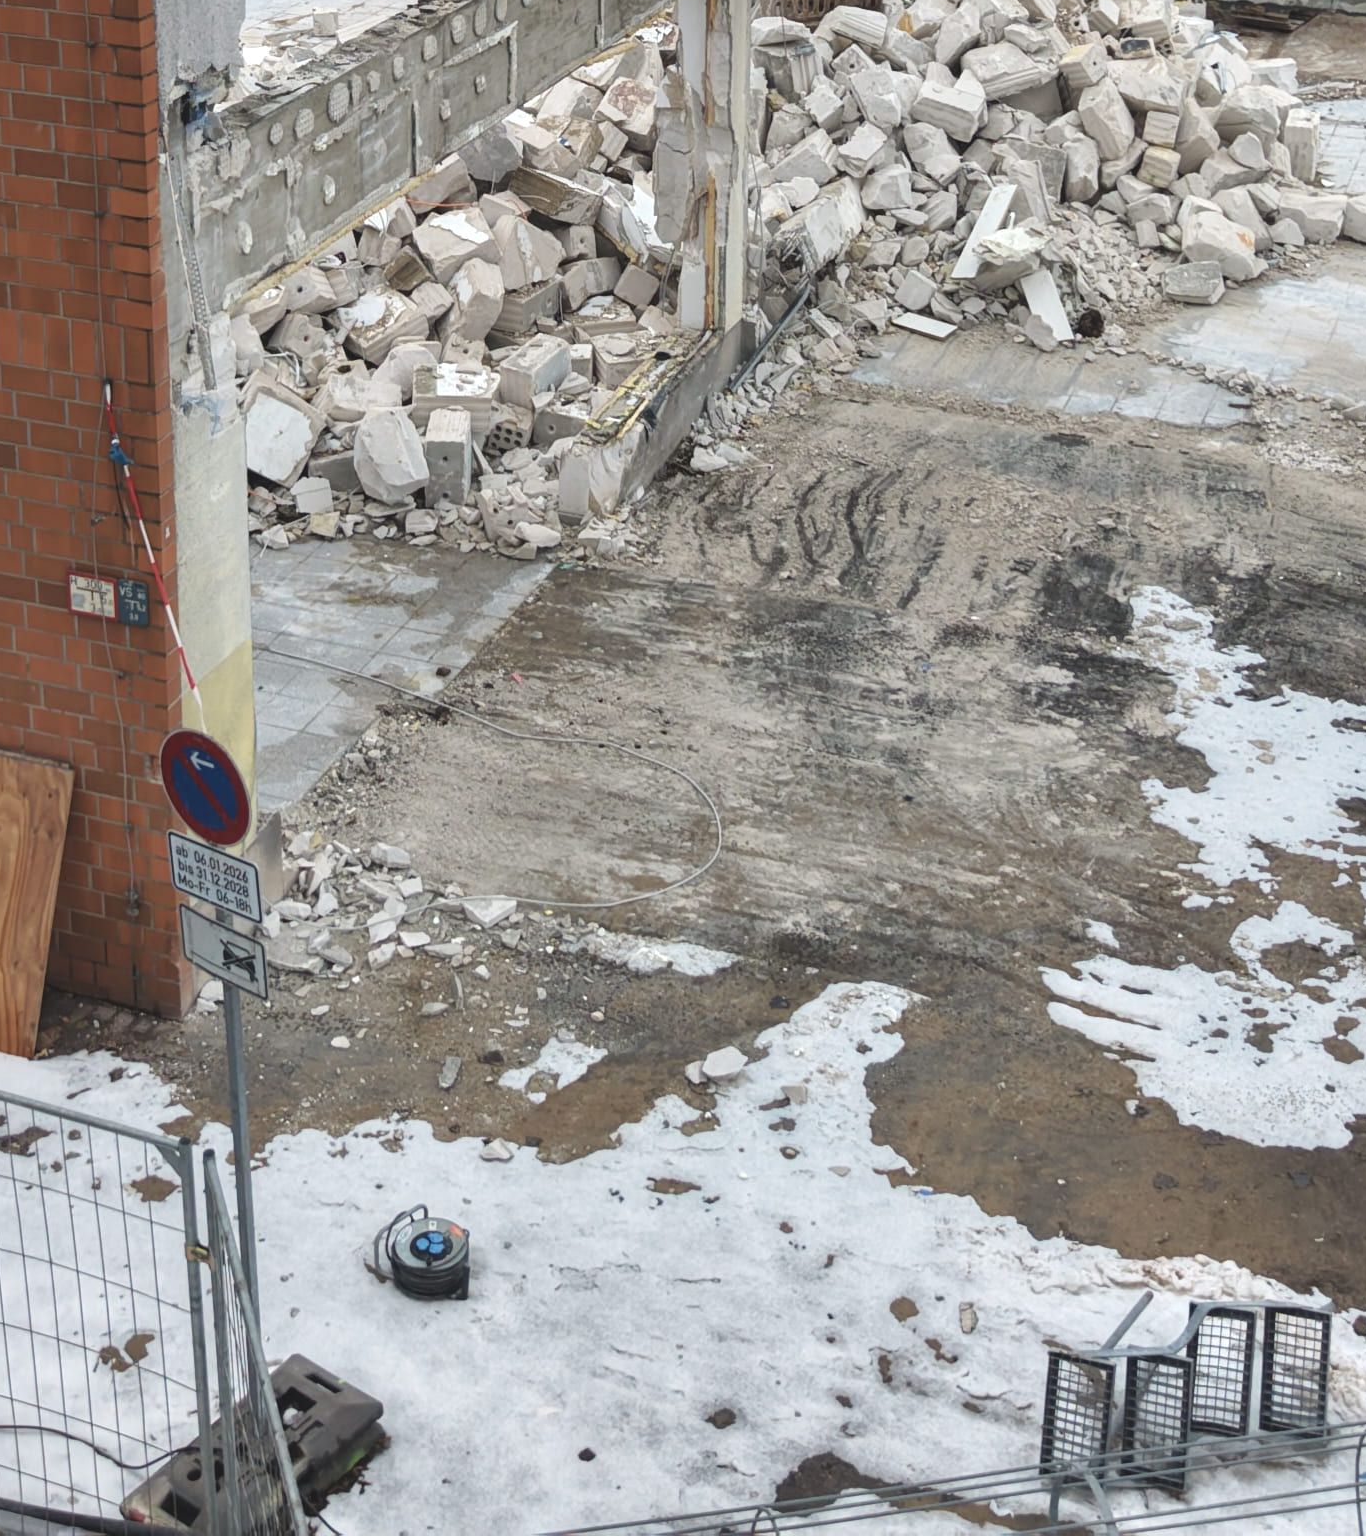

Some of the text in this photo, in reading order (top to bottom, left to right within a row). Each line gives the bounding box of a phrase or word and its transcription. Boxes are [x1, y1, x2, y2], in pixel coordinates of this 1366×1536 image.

[176, 844, 248, 883] ab 06.01.2026
[178, 858, 249, 898] bis 31.12.2028
[178, 872, 252, 914] Mo-Fr 06-18h
